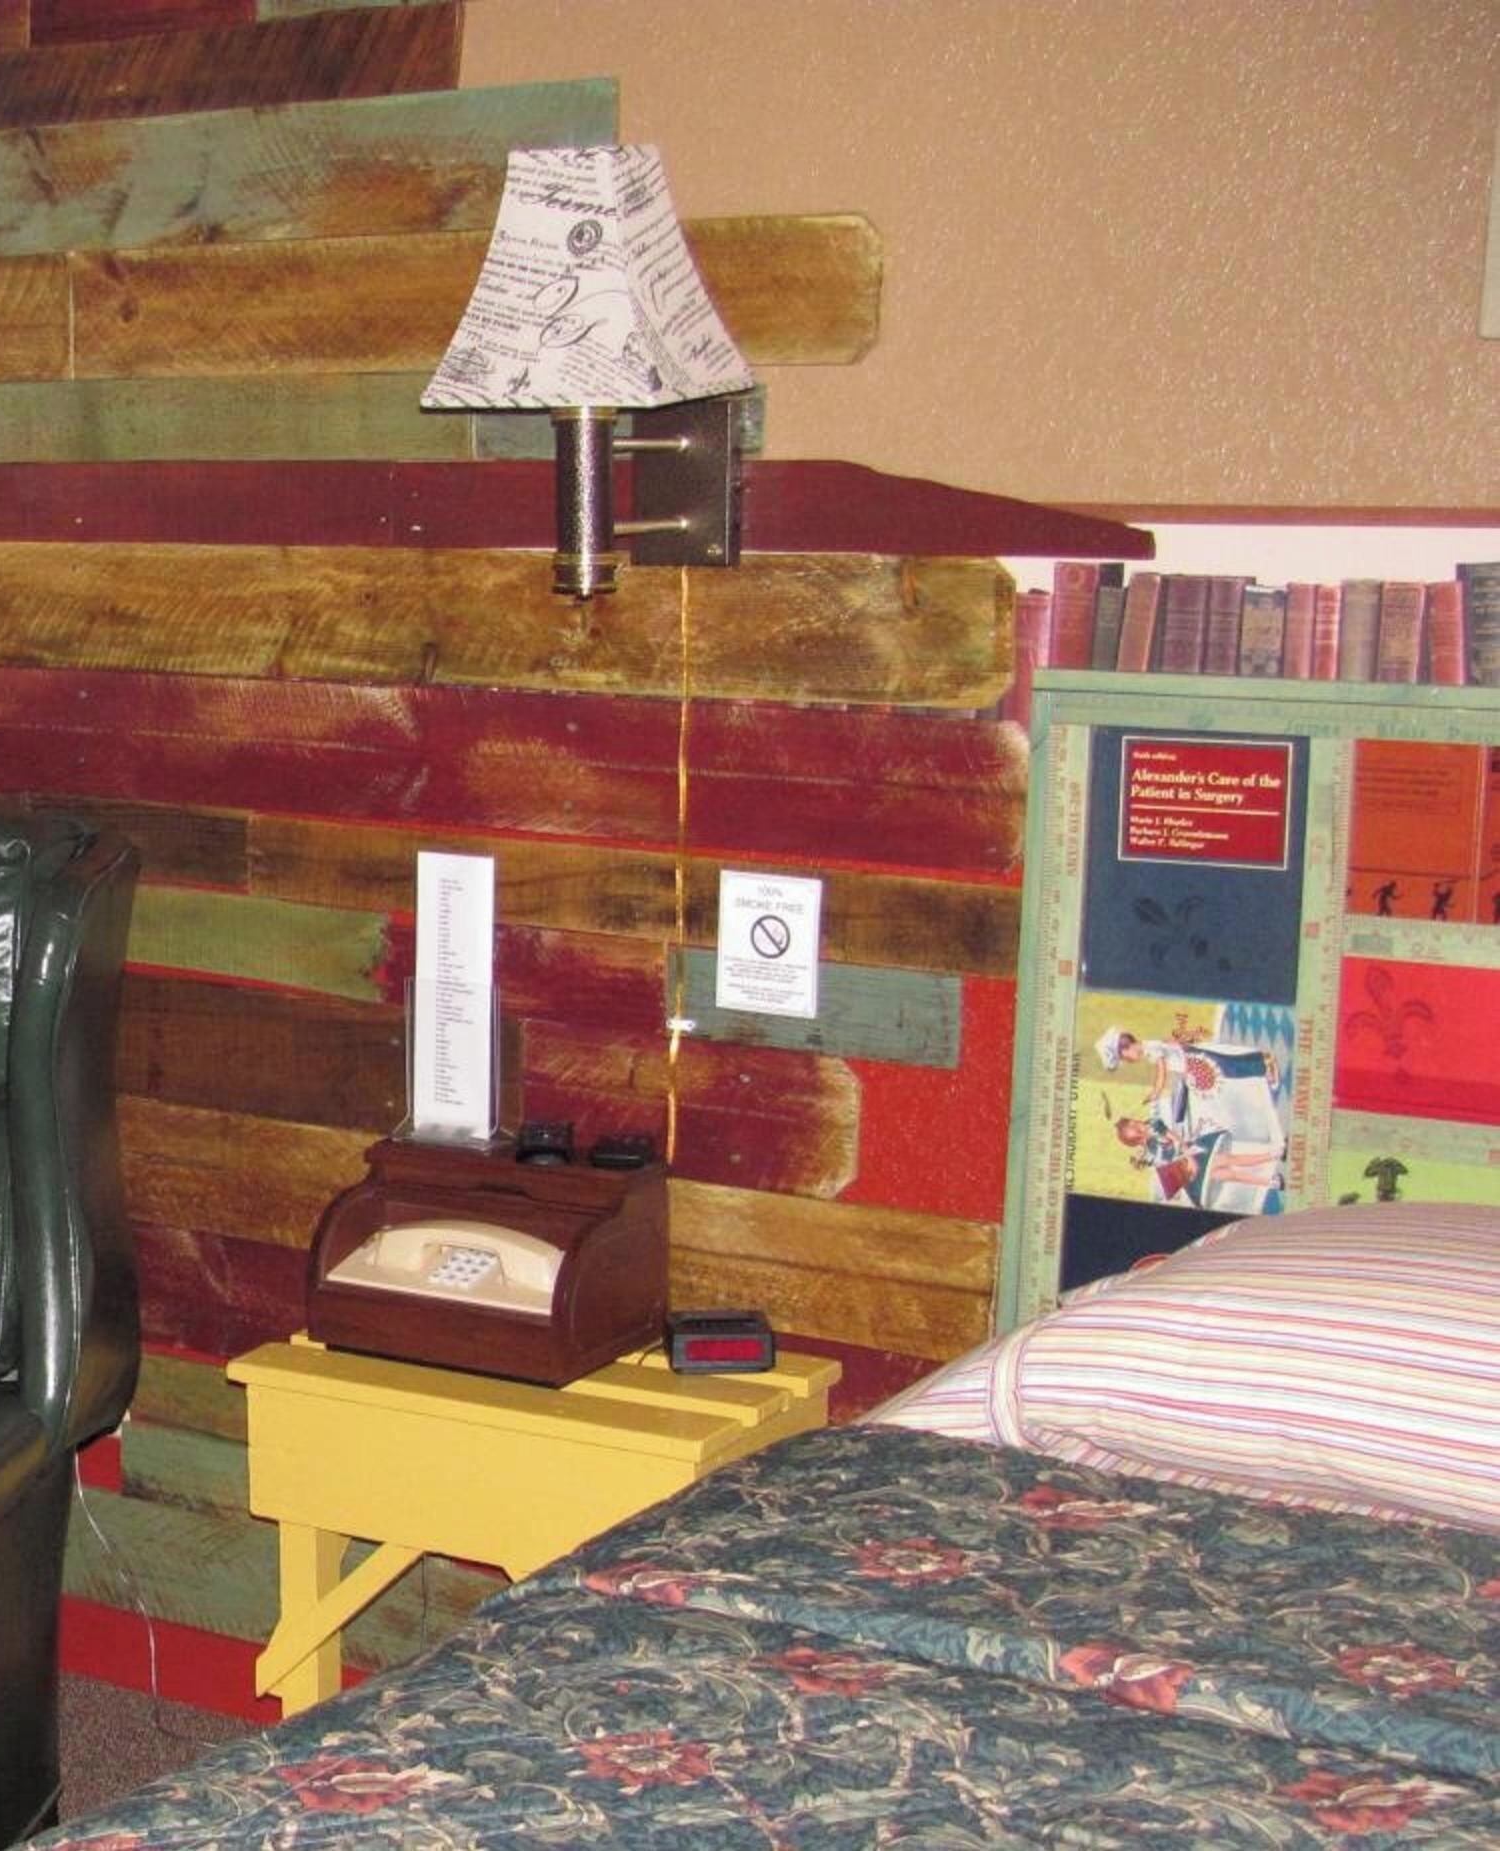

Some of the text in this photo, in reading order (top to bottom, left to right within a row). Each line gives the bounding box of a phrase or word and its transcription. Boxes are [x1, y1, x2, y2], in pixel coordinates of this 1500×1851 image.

[1131, 768, 1281, 788] Alexander's Care of the
[1130, 784, 1244, 805] Patient in Surgery
[735, 897, 805, 914] SMOKE FREE
